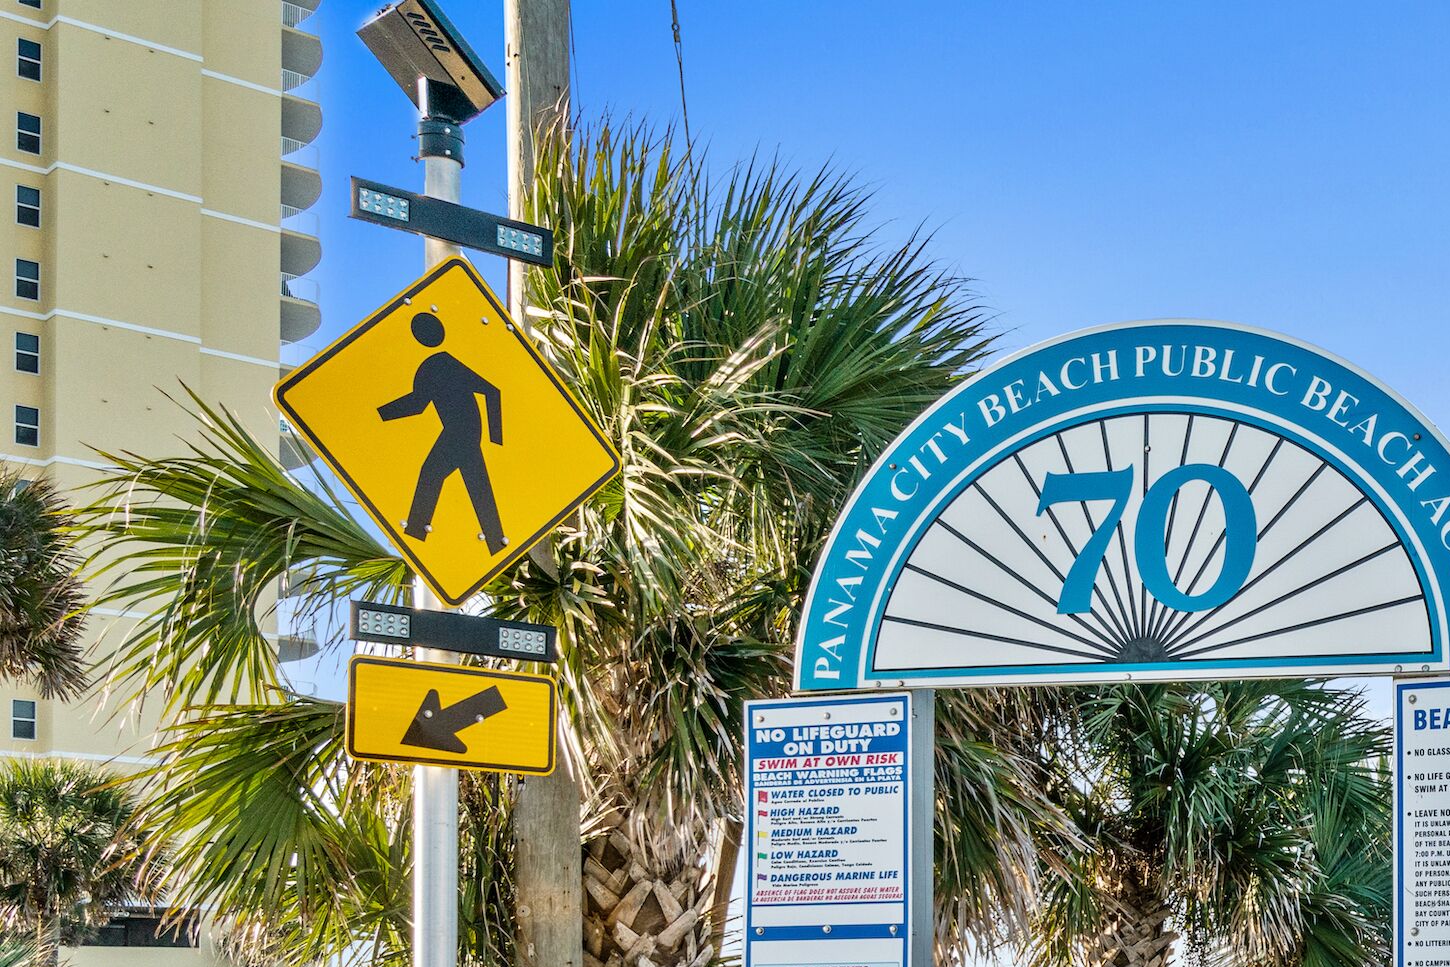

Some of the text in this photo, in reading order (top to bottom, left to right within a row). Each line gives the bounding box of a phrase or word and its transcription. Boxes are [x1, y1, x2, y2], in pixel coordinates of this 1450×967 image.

[813, 510, 900, 681] PANAMA
[891, 414, 969, 502] CITY
[976, 349, 1120, 429] BEACH
[1134, 345, 1298, 395] PUBLIC
[1300, 376, 1438, 491] BEACH
[1036, 462, 1258, 615] 70
[756, 723, 900, 743] NO LIFEGUARD
[783, 738, 872, 756] ON DUTY
[1427, 748, 1450, 756] GLASS
[758, 754, 898, 769] SWIM AT OWN RISK
[753, 767, 903, 781] BEACH WARNING FLAGS
[1414, 773, 1425, 781] NO
[1427, 772, 1443, 780] LIFE
[771, 790, 804, 799] WATER
[807, 788, 844, 797] CLOSED
[864, 786, 899, 795] PUBLIC
[1414, 785, 1436, 793] SWIM
[770, 806, 840, 817] HIGH HAZARD
[1414, 809, 1438, 817] LEAVE
[771, 826, 858, 837] MEDIUM HAZARD
[770, 850, 838, 859] LOW HAZARD
[770, 871, 899, 882] DANGEROUS MARINE LIFE
